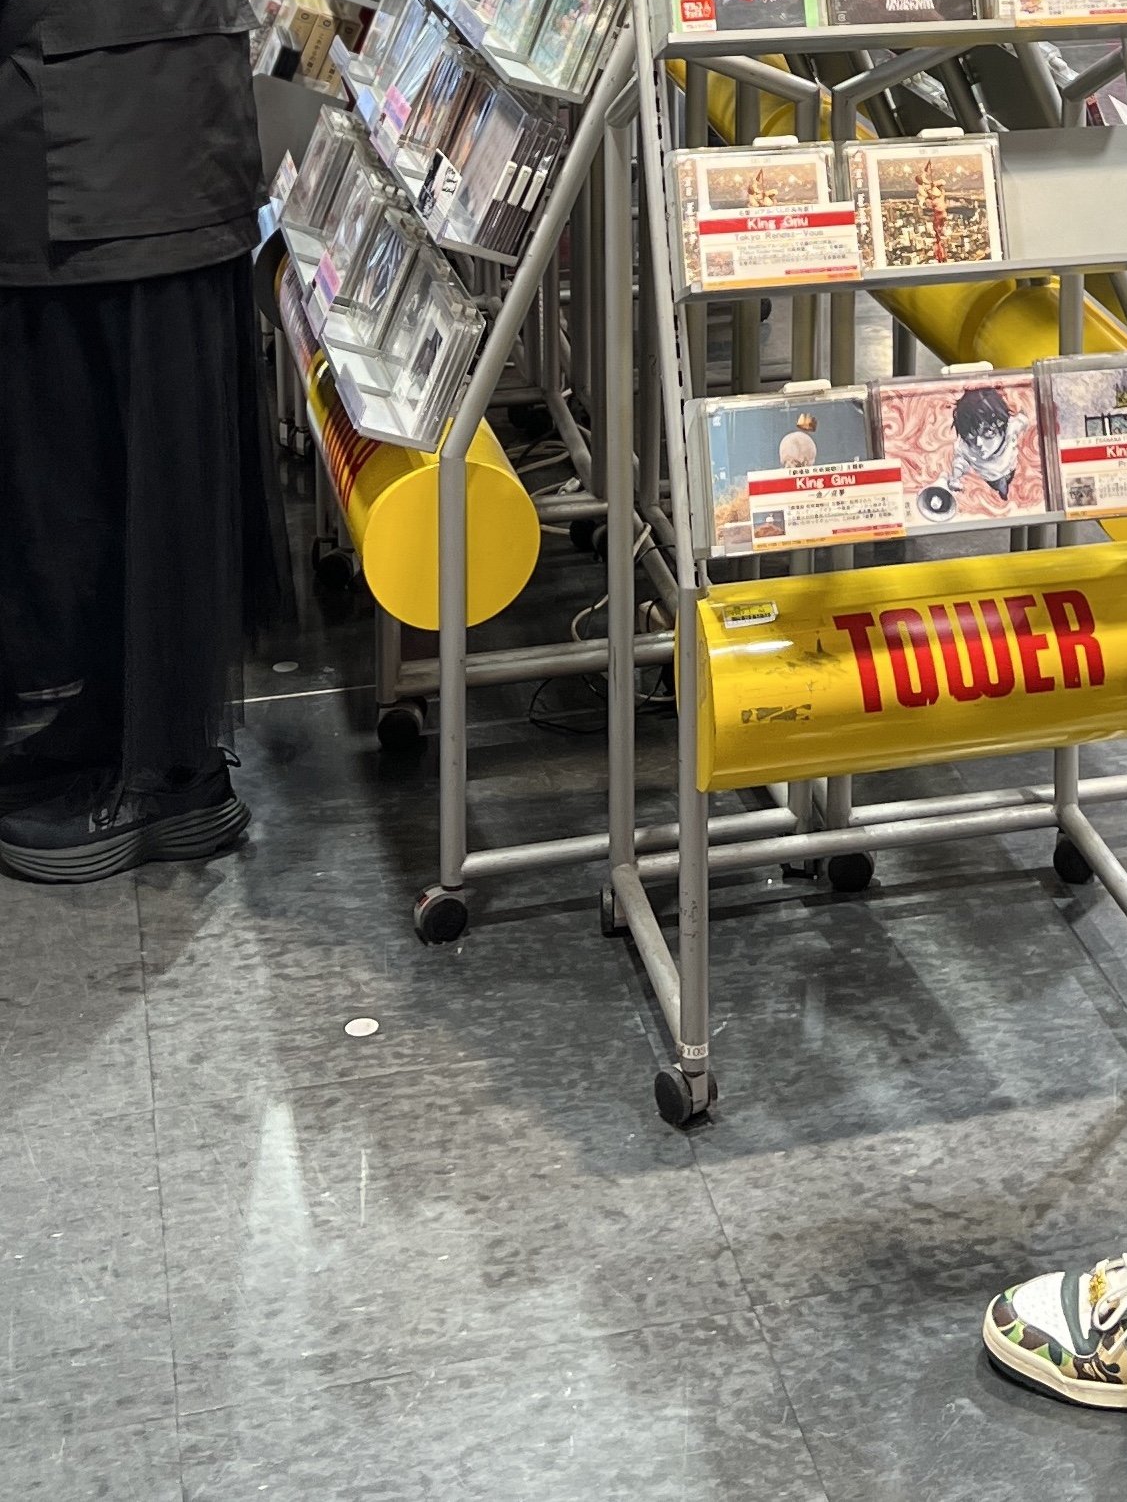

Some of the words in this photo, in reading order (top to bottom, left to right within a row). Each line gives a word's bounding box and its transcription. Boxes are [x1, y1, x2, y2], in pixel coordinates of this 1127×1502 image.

[747, 218, 776, 230] King
[782, 215, 809, 228] Gnu
[796, 477, 825, 490] King
[830, 474, 856, 486] Gnu
[833, 589, 1106, 714] TOWER
